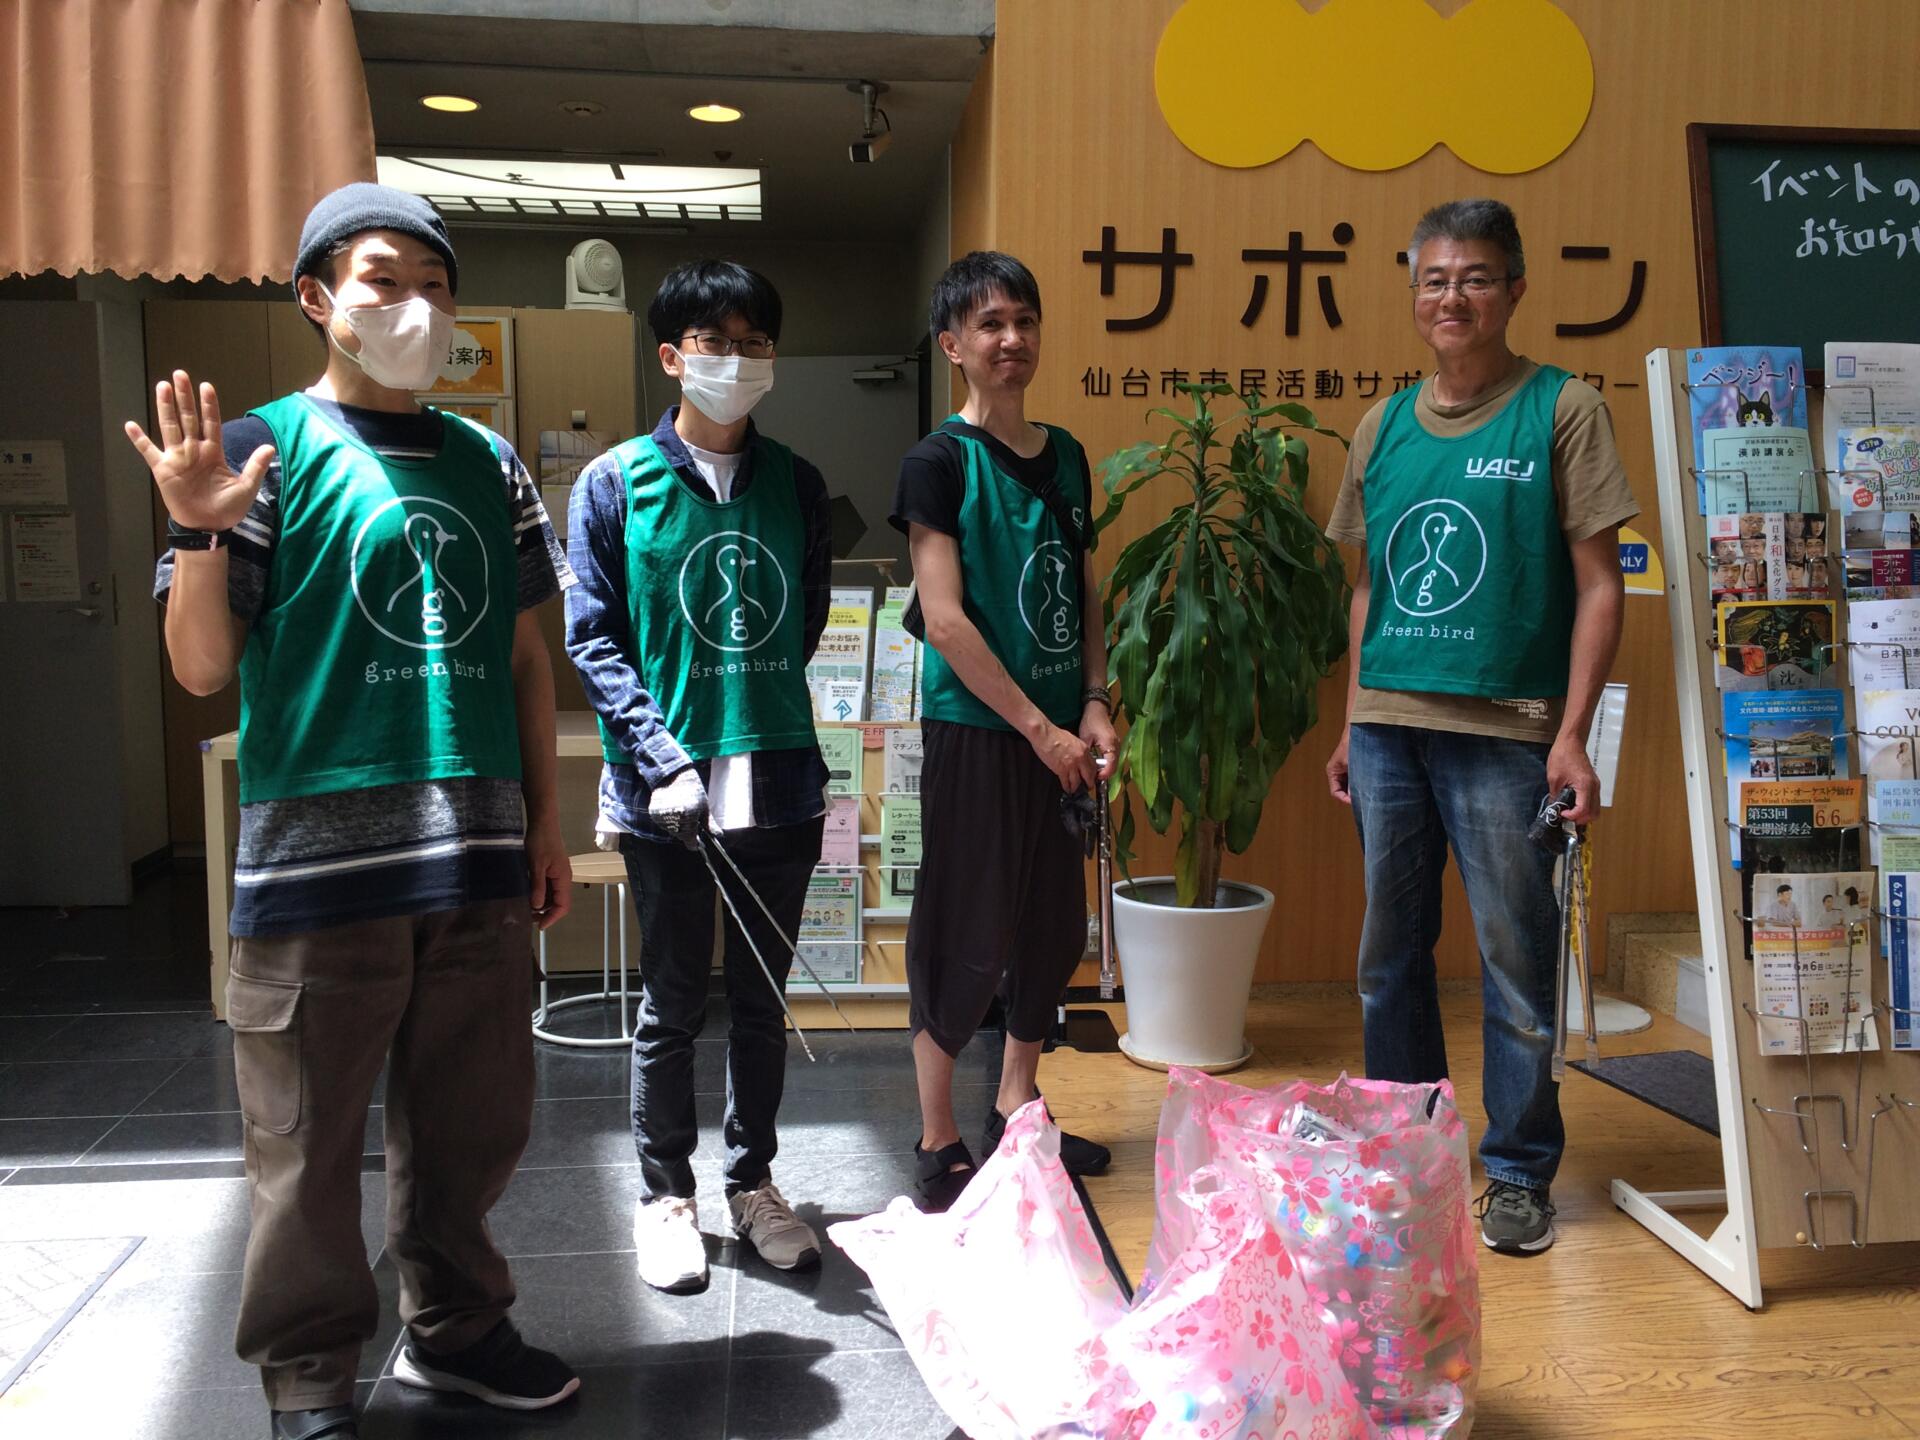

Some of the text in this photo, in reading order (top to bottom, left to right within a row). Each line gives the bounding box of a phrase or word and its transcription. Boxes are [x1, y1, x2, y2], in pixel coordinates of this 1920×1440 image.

[1464, 458, 1535, 481] UACJ
[1619, 556, 1644, 568] NLY
[1429, 625, 1475, 640] bird
[365, 659, 485, 684] green bird
[1031, 661, 1071, 680] green
[1748, 807, 1788, 820] 第53回
[1748, 822, 1812, 836] 定期演奏会
